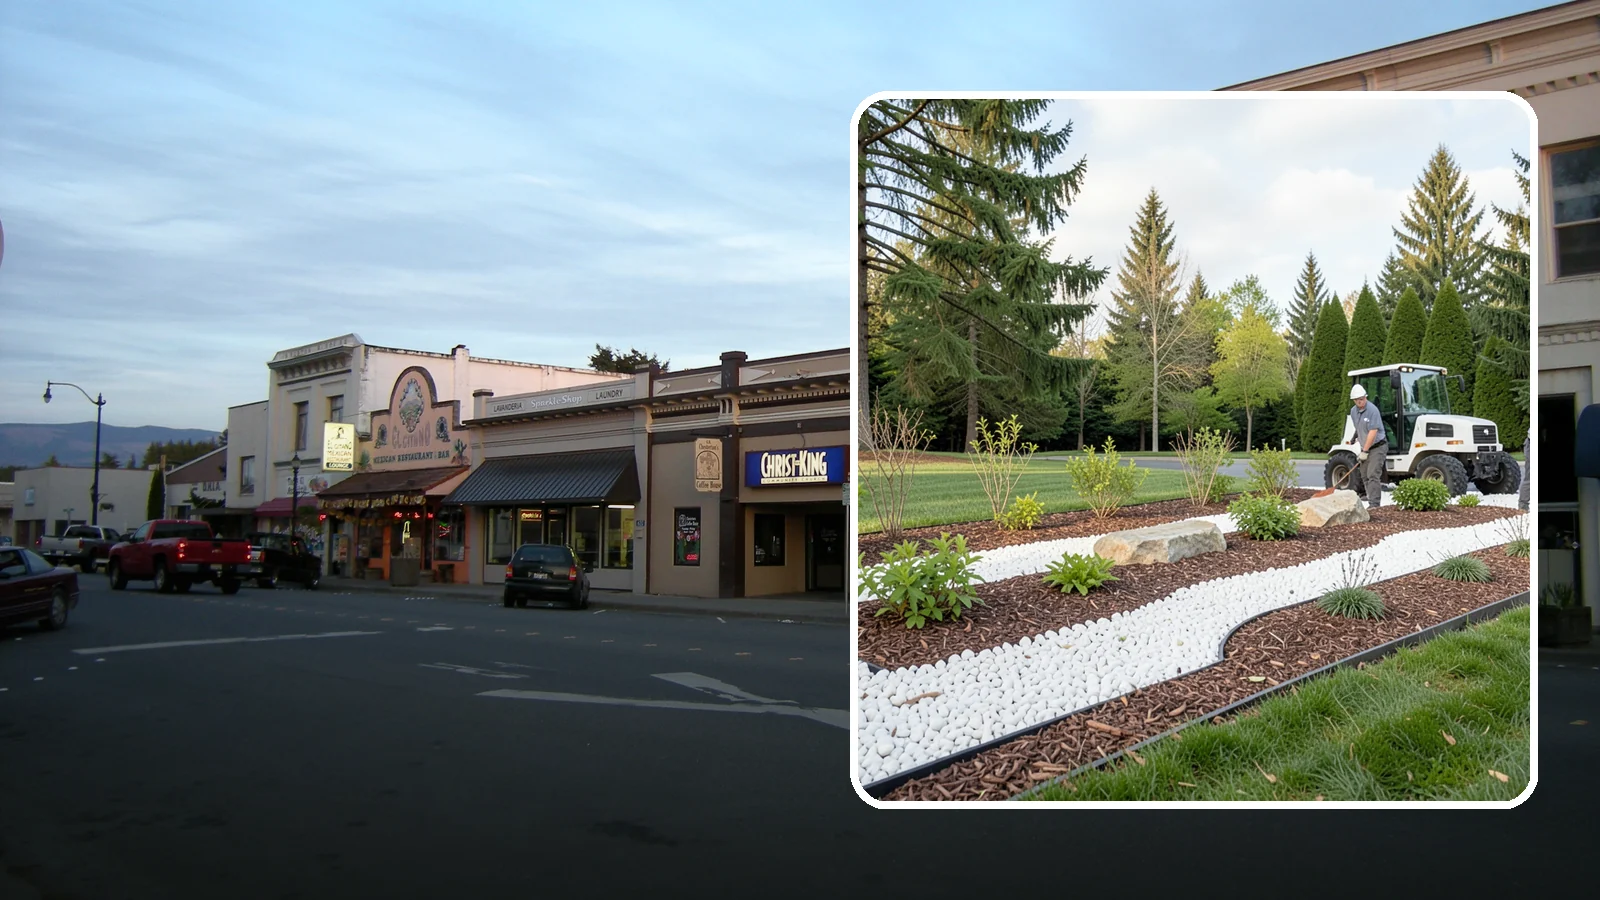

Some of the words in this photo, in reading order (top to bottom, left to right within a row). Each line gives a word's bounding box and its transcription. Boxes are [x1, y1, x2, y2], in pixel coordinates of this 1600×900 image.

[596, 389, 623, 400] LAUNDRY
[562, 395, 582, 406] Shop
[493, 402, 522, 412] LAVANDERIA
[327, 449, 352, 457] MEXICAN
[374, 455, 396, 464] MEXICAN
[398, 451, 433, 461] RESTAURANT
[438, 450, 450, 459] BAR
[761, 452, 797, 478] CHRIST
[799, 450, 827, 477] KING
[696, 480, 709, 489] Coffee
[710, 480, 722, 489] House
